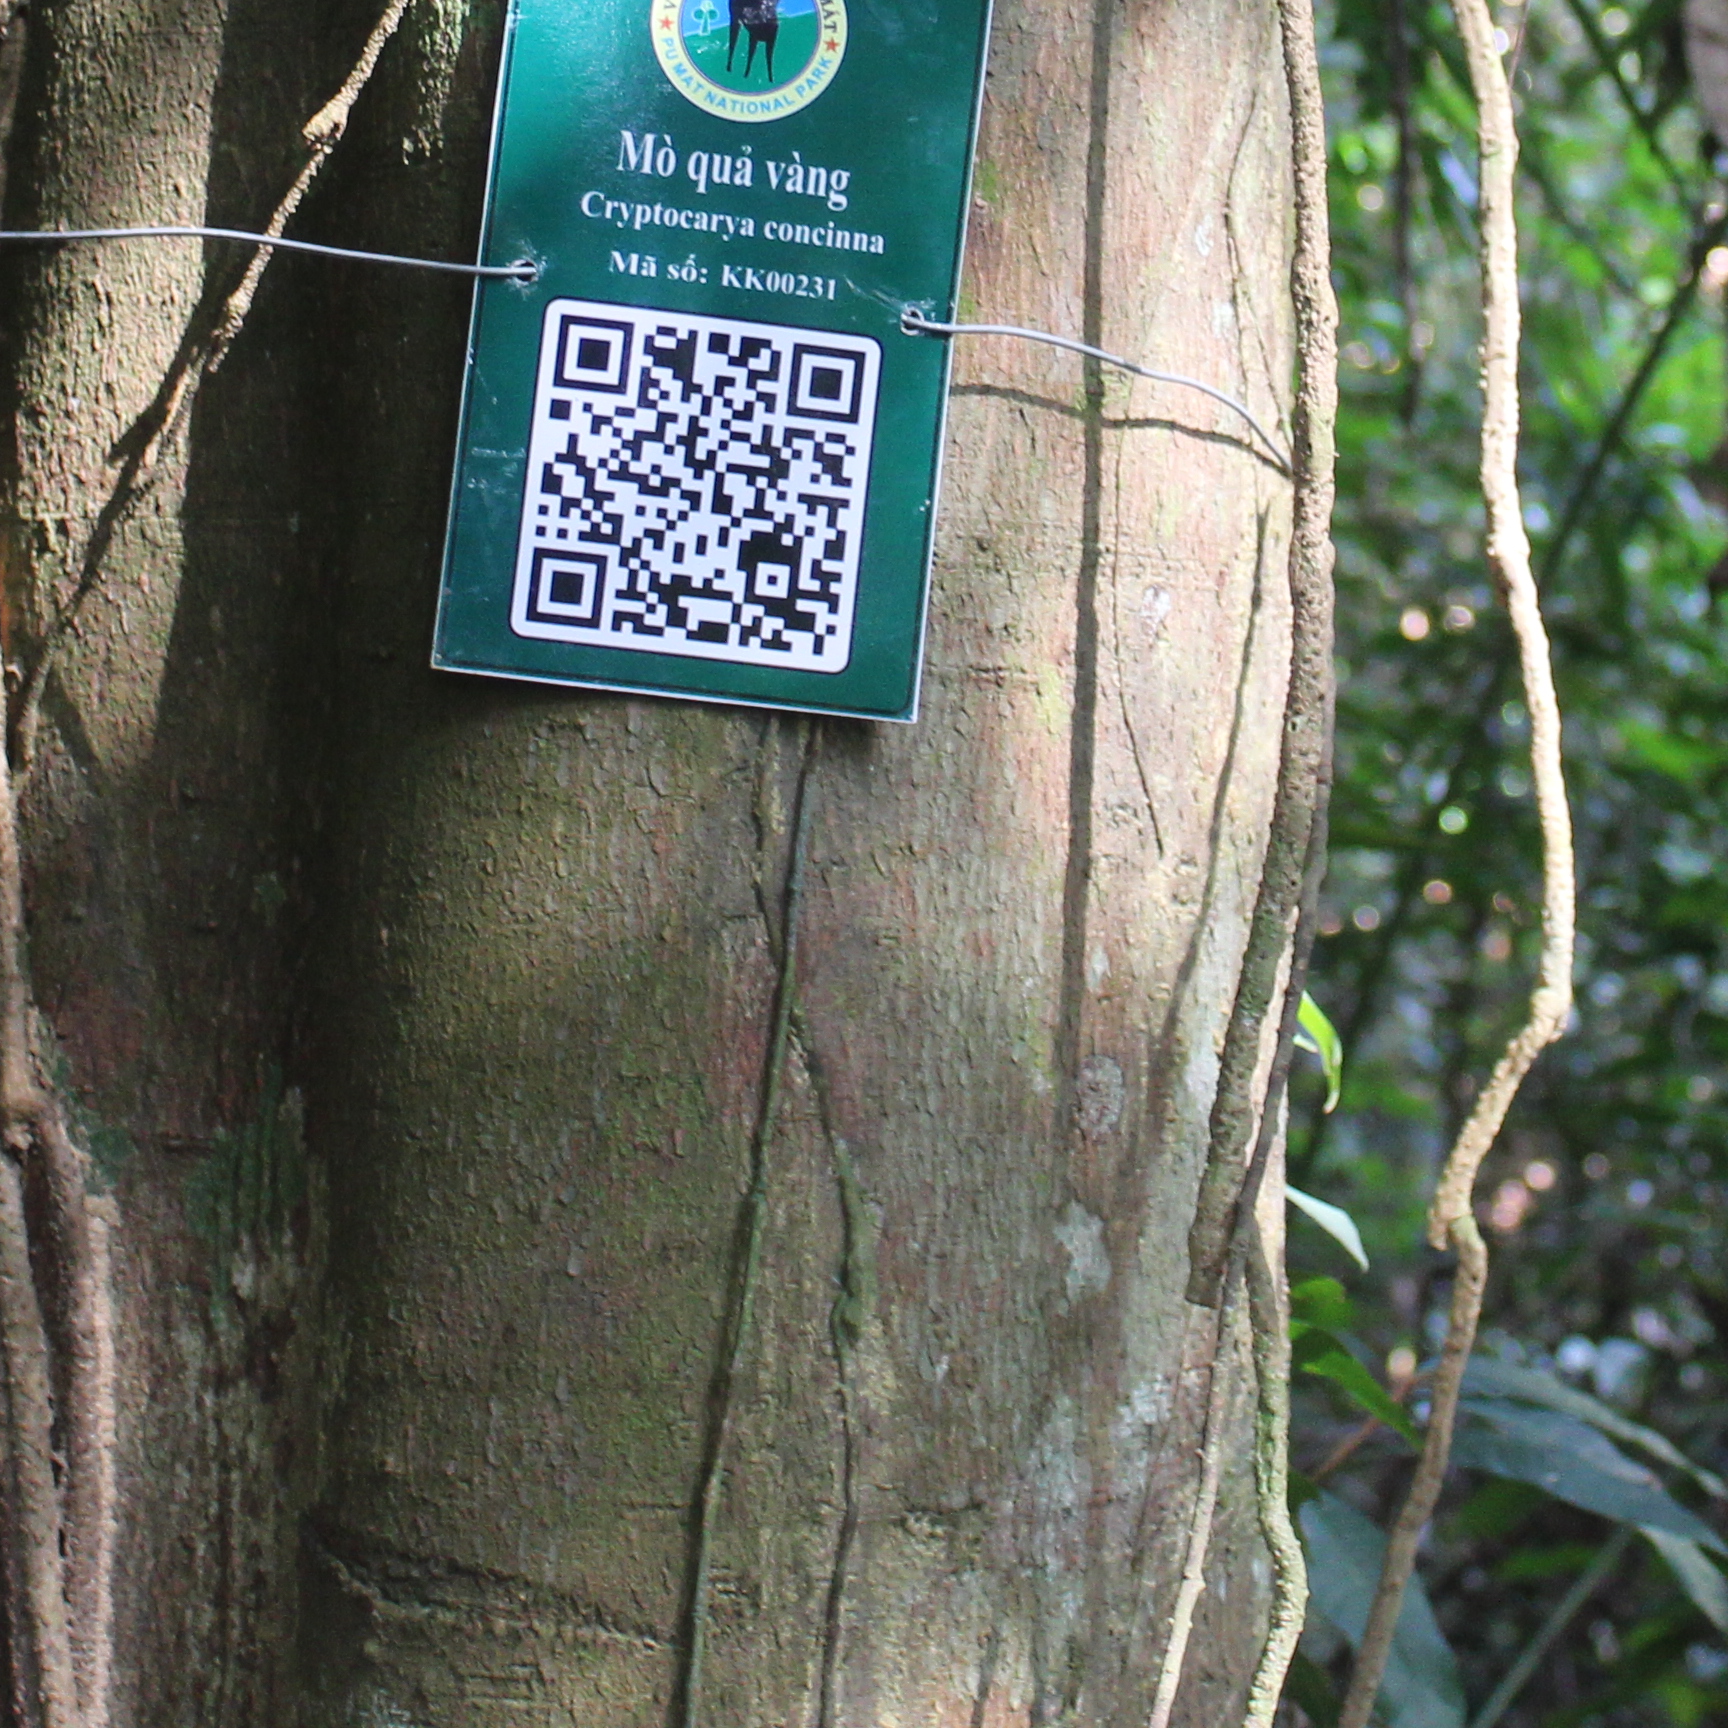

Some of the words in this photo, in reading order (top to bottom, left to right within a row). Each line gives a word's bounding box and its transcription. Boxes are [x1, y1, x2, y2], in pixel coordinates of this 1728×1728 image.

[662, 37, 679, 60] PU
[672, 64, 704, 92] MAT
[704, 90, 795, 115] NATIONAL
[795, 56, 833, 98] PARK
[616, 129, 676, 177] Mò
[687, 145, 753, 194] quả
[766, 151, 851, 211] vàng
[580, 190, 755, 241] Cryptocarya
[763, 221, 885, 254] concinna
[609, 250, 657, 278] Mã
[667, 254, 709, 284] số:
[721, 264, 837, 301] KK00231
